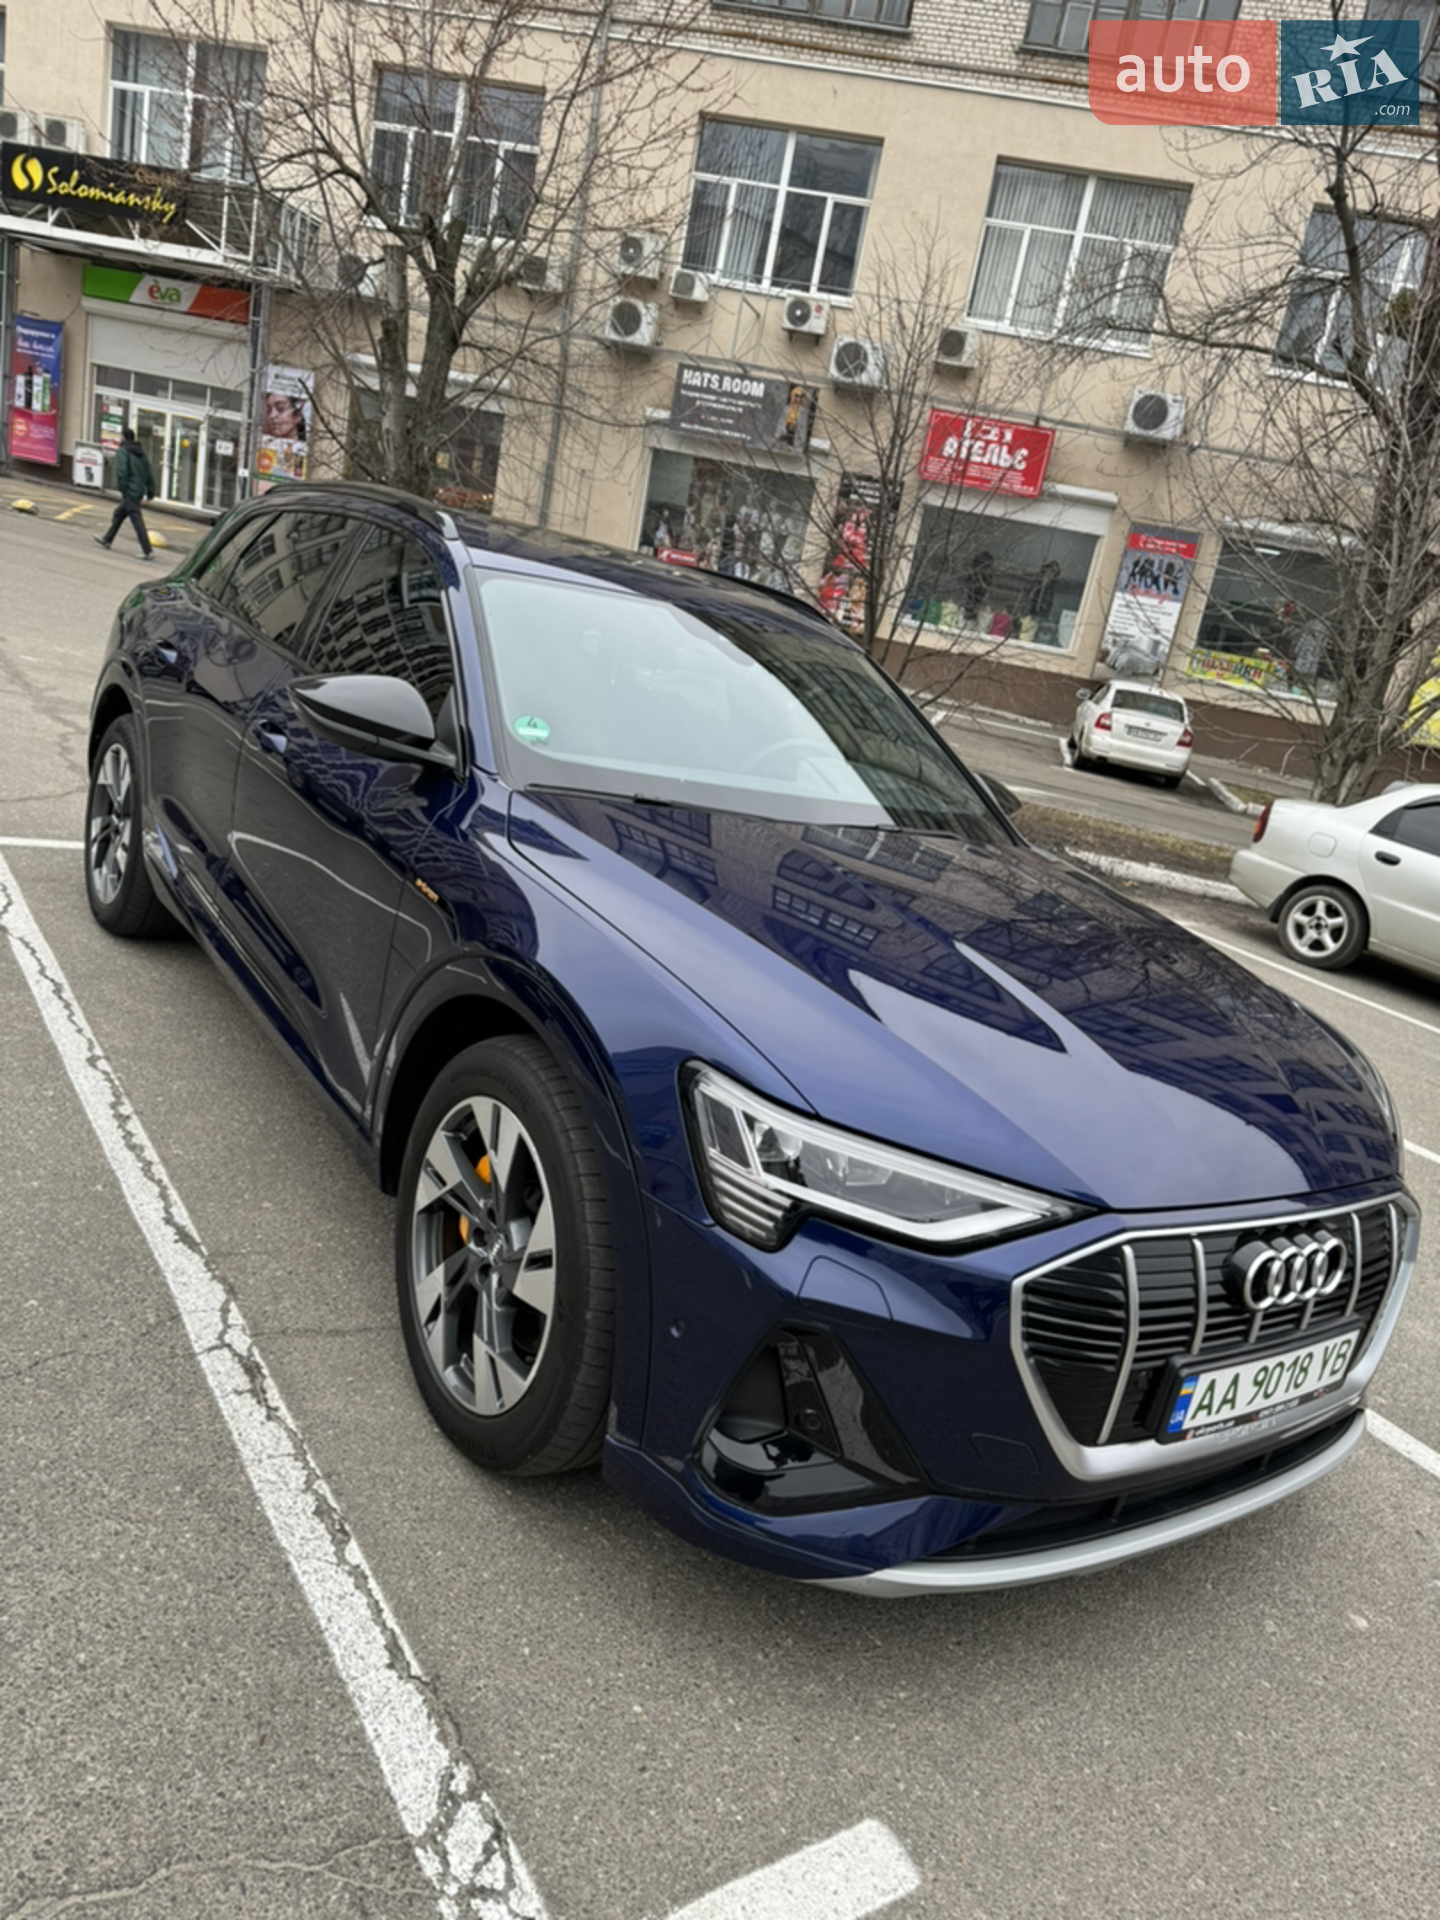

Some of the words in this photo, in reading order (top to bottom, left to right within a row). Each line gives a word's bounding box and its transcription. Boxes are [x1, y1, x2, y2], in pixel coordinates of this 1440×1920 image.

[46, 165, 177, 224] Solomiansky
[1190, 1372, 1240, 1421] AA
[1246, 1351, 1314, 1406] 9018
[1317, 1338, 1353, 1382] YB
